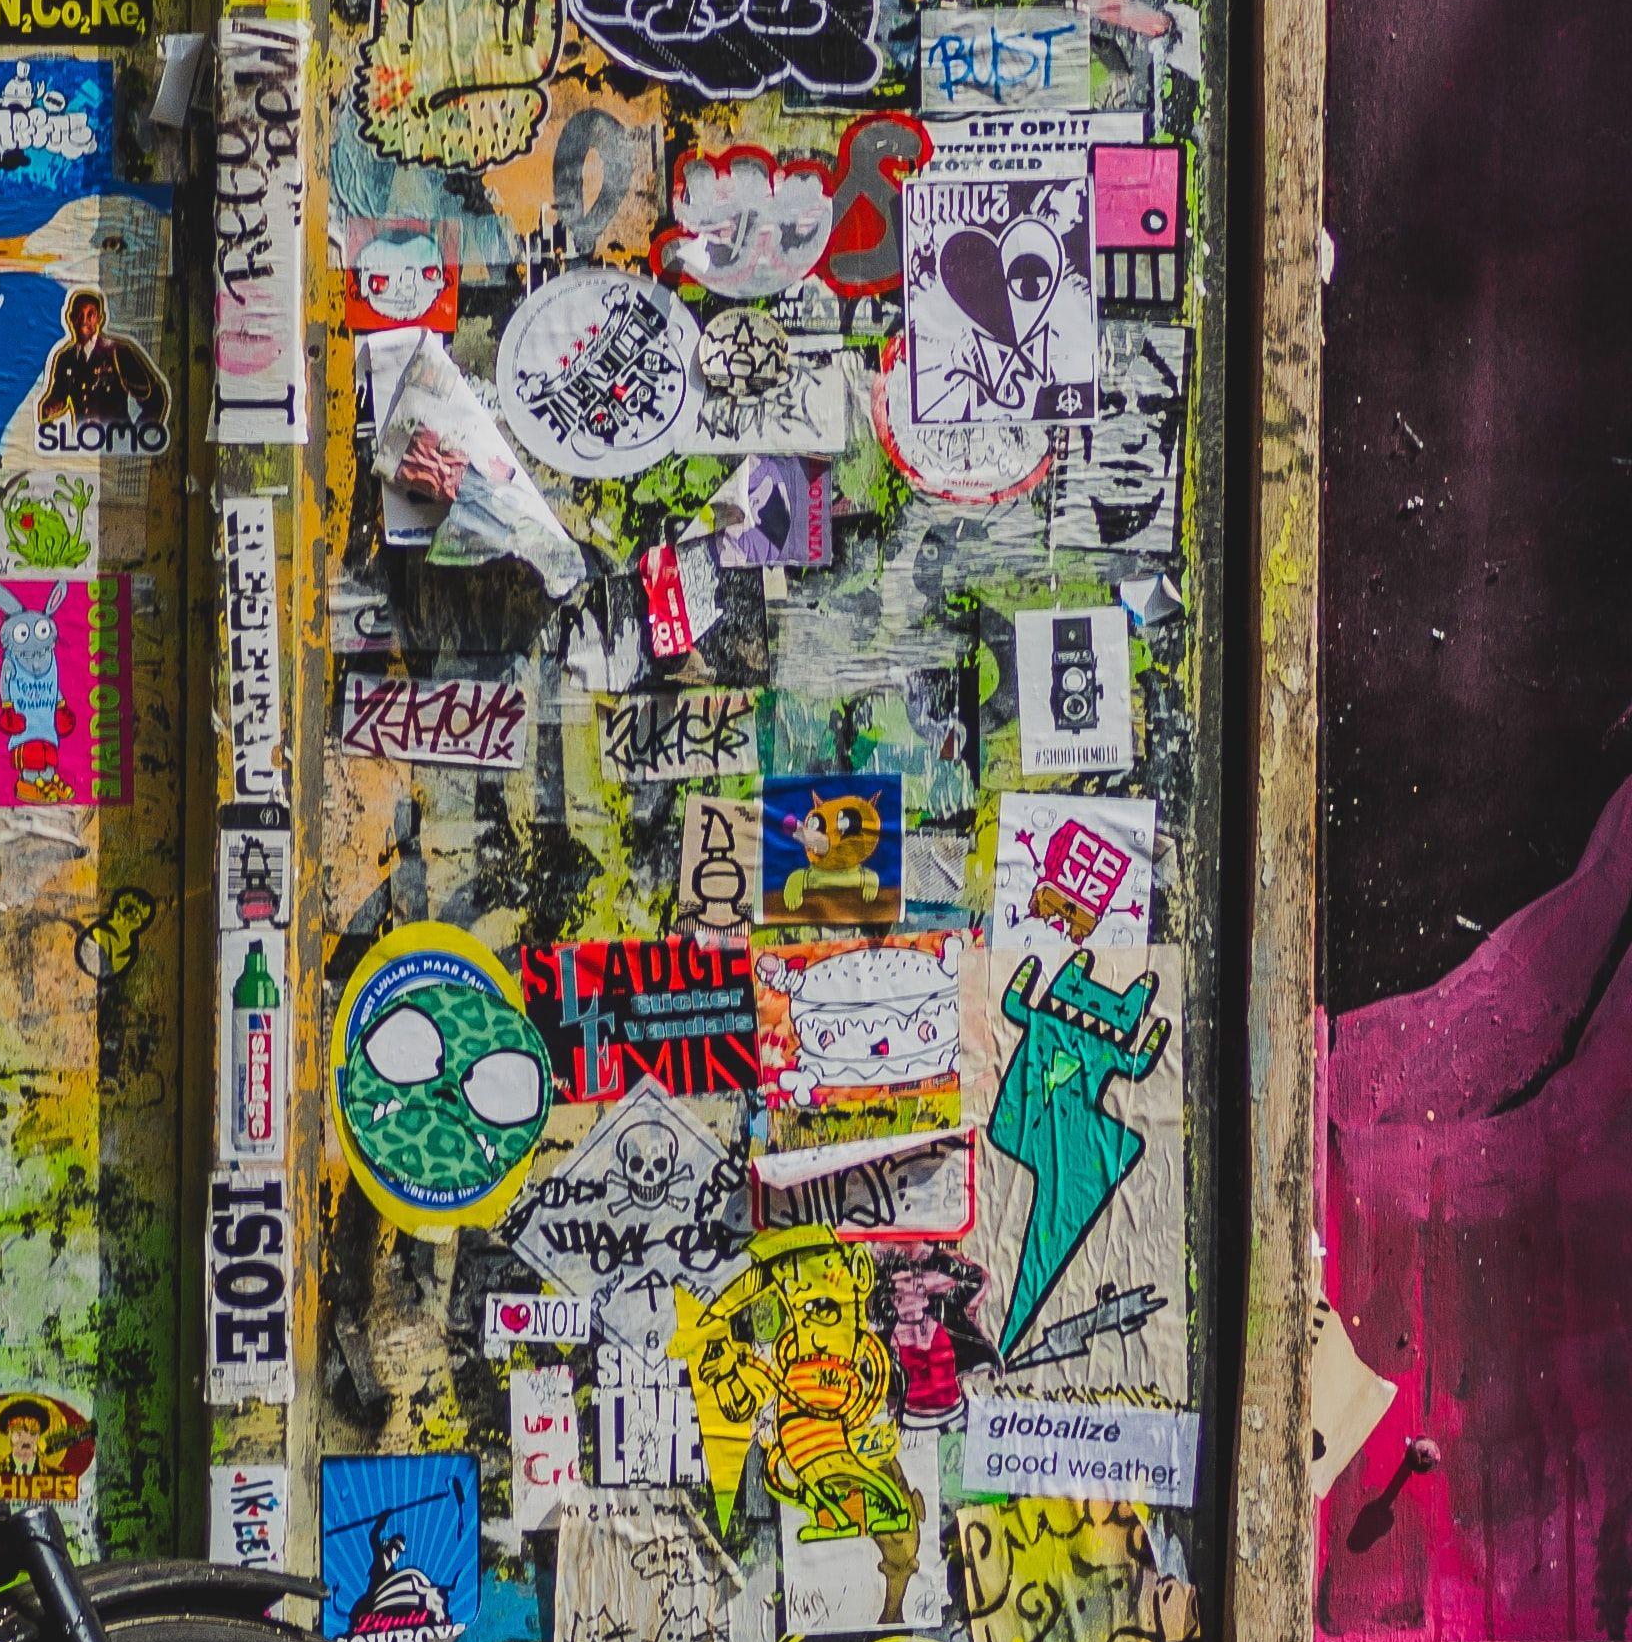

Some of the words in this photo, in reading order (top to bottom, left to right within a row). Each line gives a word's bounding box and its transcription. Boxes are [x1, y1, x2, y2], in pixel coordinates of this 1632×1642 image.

[968, 121, 1015, 137] LET
[37, 420, 169, 455] SLOMO
[87, 579, 120, 676] BOKS
[532, 1298, 586, 1338] NOL
[988, 1412, 1121, 1442] globalize
[986, 1451, 1059, 1478] good
[1068, 1455, 1182, 1487] weather.
[353, 1609, 429, 1635] Liquid
